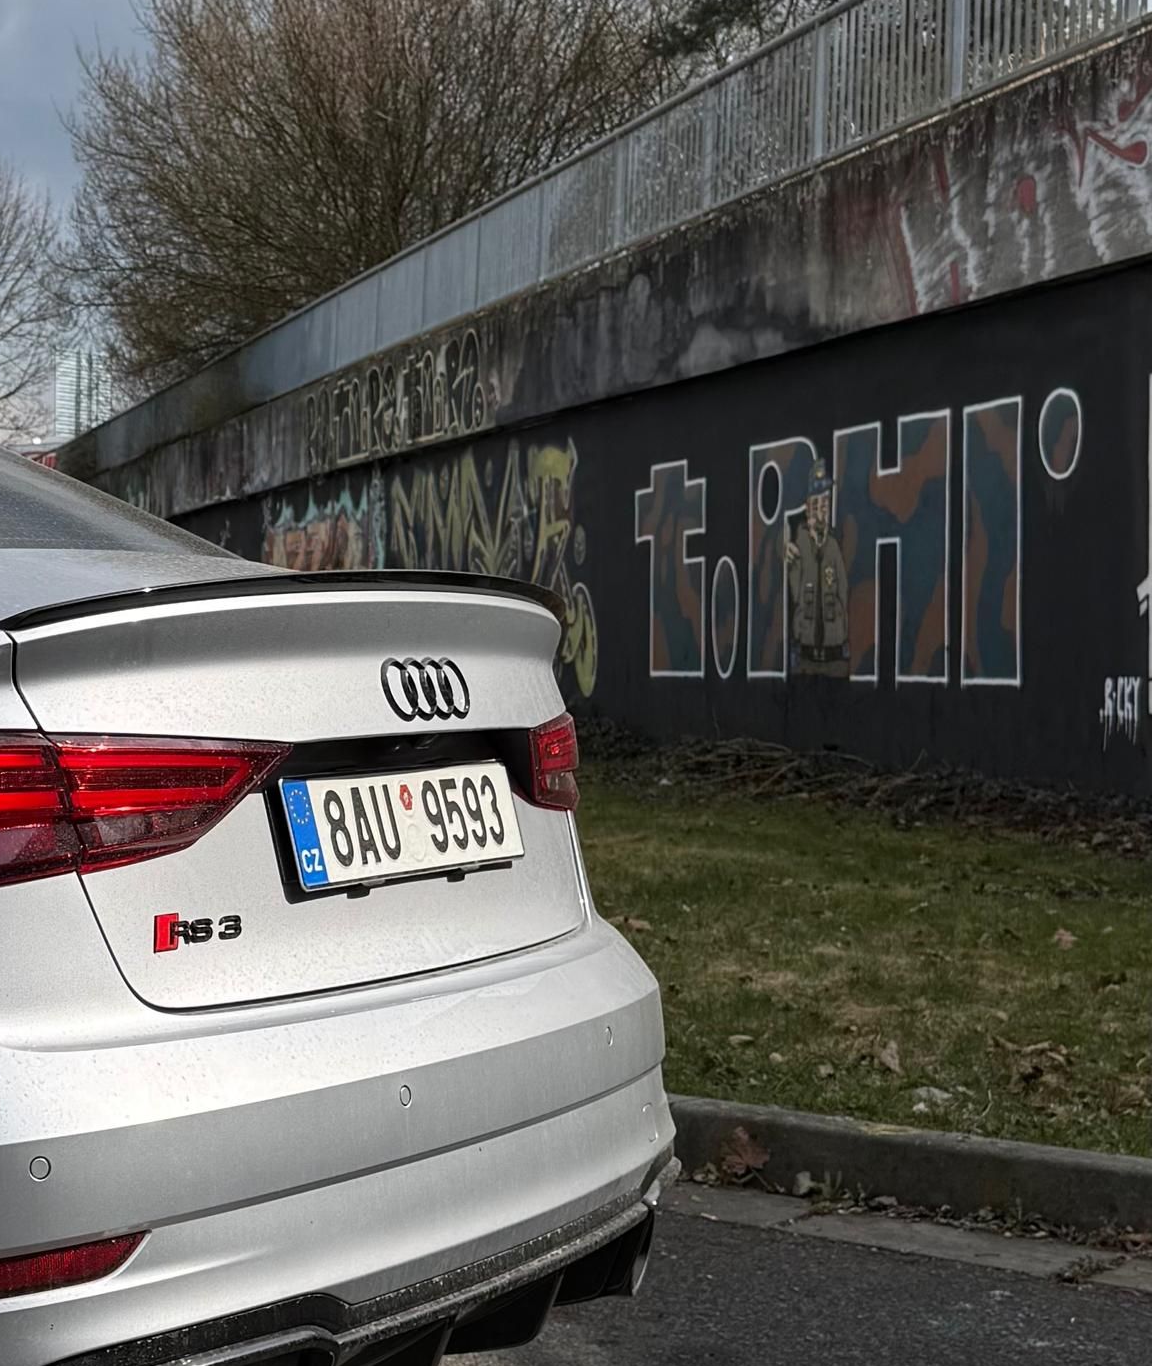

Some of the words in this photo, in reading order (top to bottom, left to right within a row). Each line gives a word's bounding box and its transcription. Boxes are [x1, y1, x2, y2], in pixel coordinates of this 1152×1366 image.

[323, 784, 401, 867] 8AU
[421, 774, 504, 853] 9593
[301, 849, 323, 873] CZ
[218, 914, 242, 940] 3
